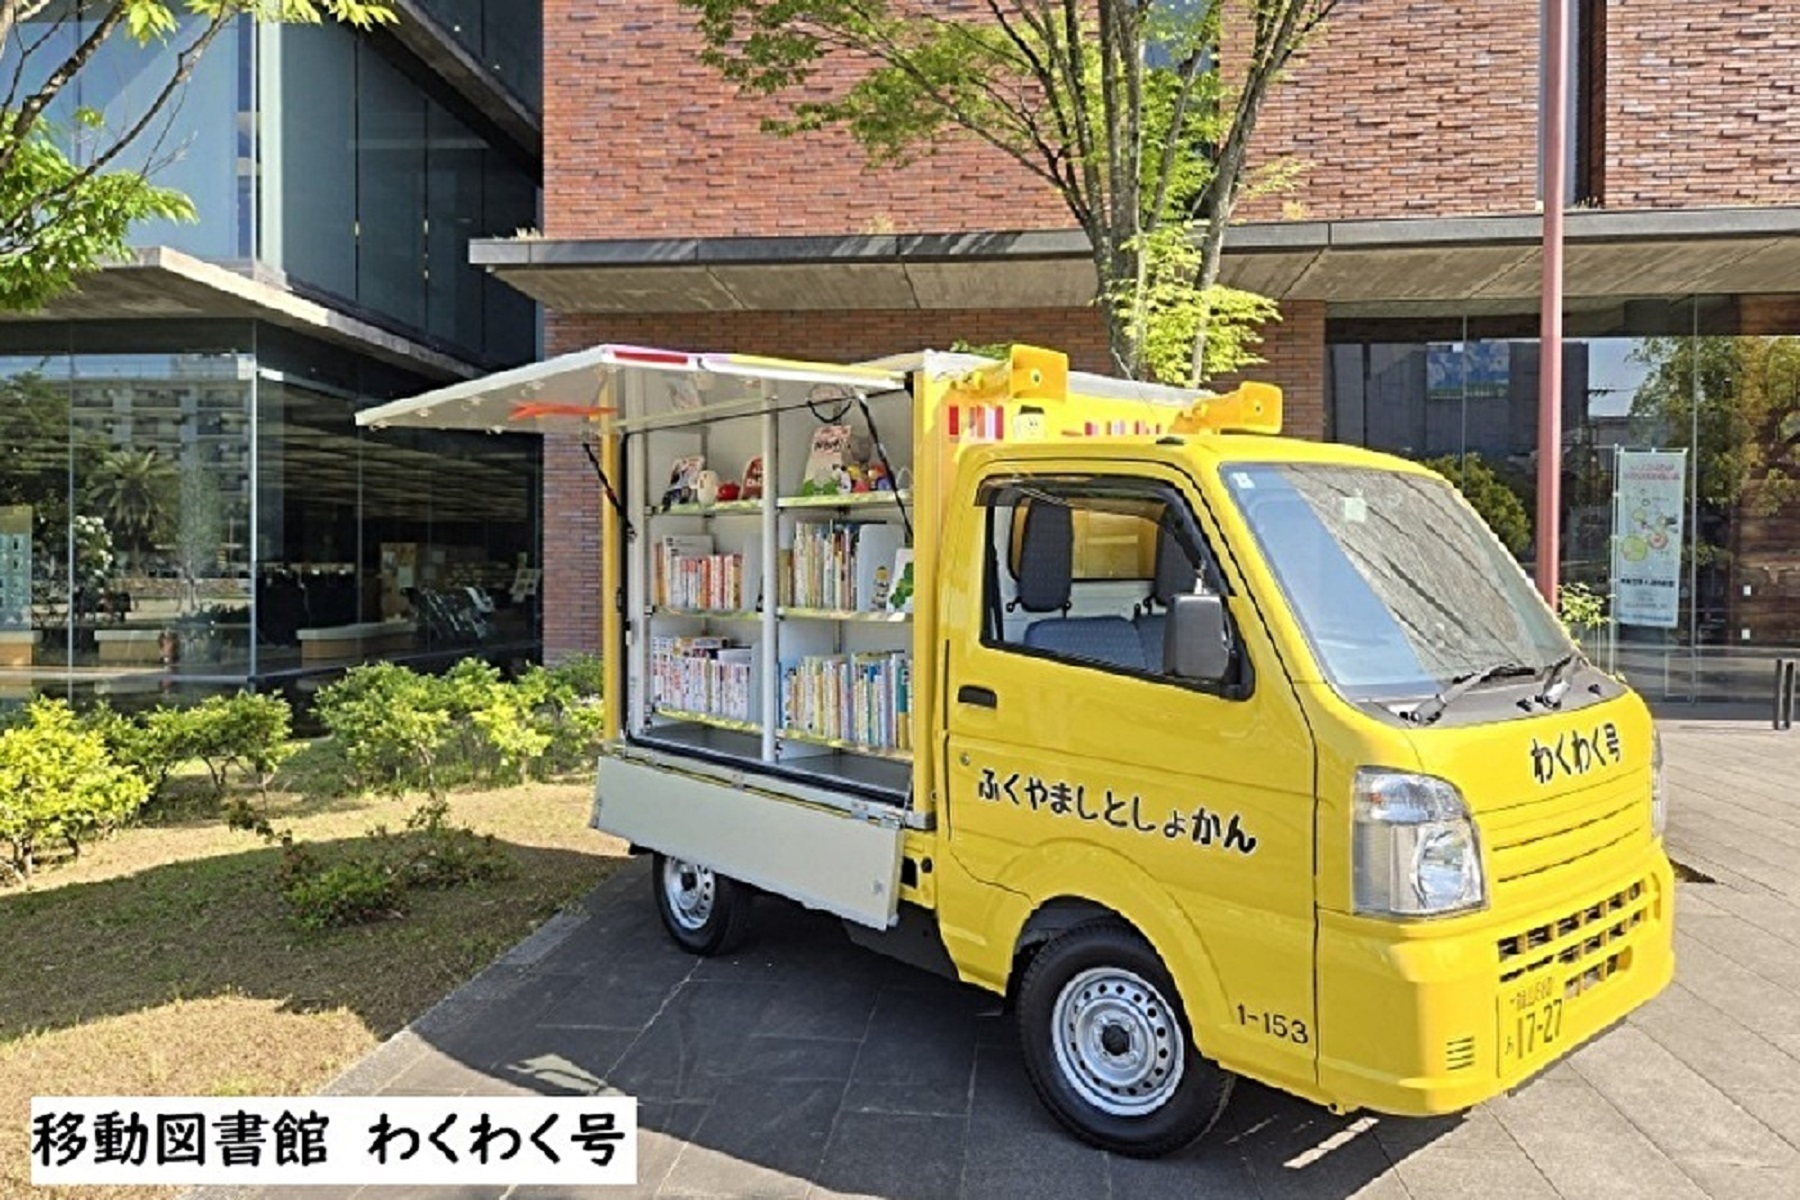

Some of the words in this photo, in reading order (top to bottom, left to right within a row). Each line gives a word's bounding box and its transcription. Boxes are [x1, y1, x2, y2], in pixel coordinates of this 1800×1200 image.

[1530, 722, 1620, 783] わくわく号
[977, 768, 1257, 854] ふくやましとしょかん
[1237, 1003, 1309, 1044] 1-153
[1517, 998, 1562, 1059] 17-27
